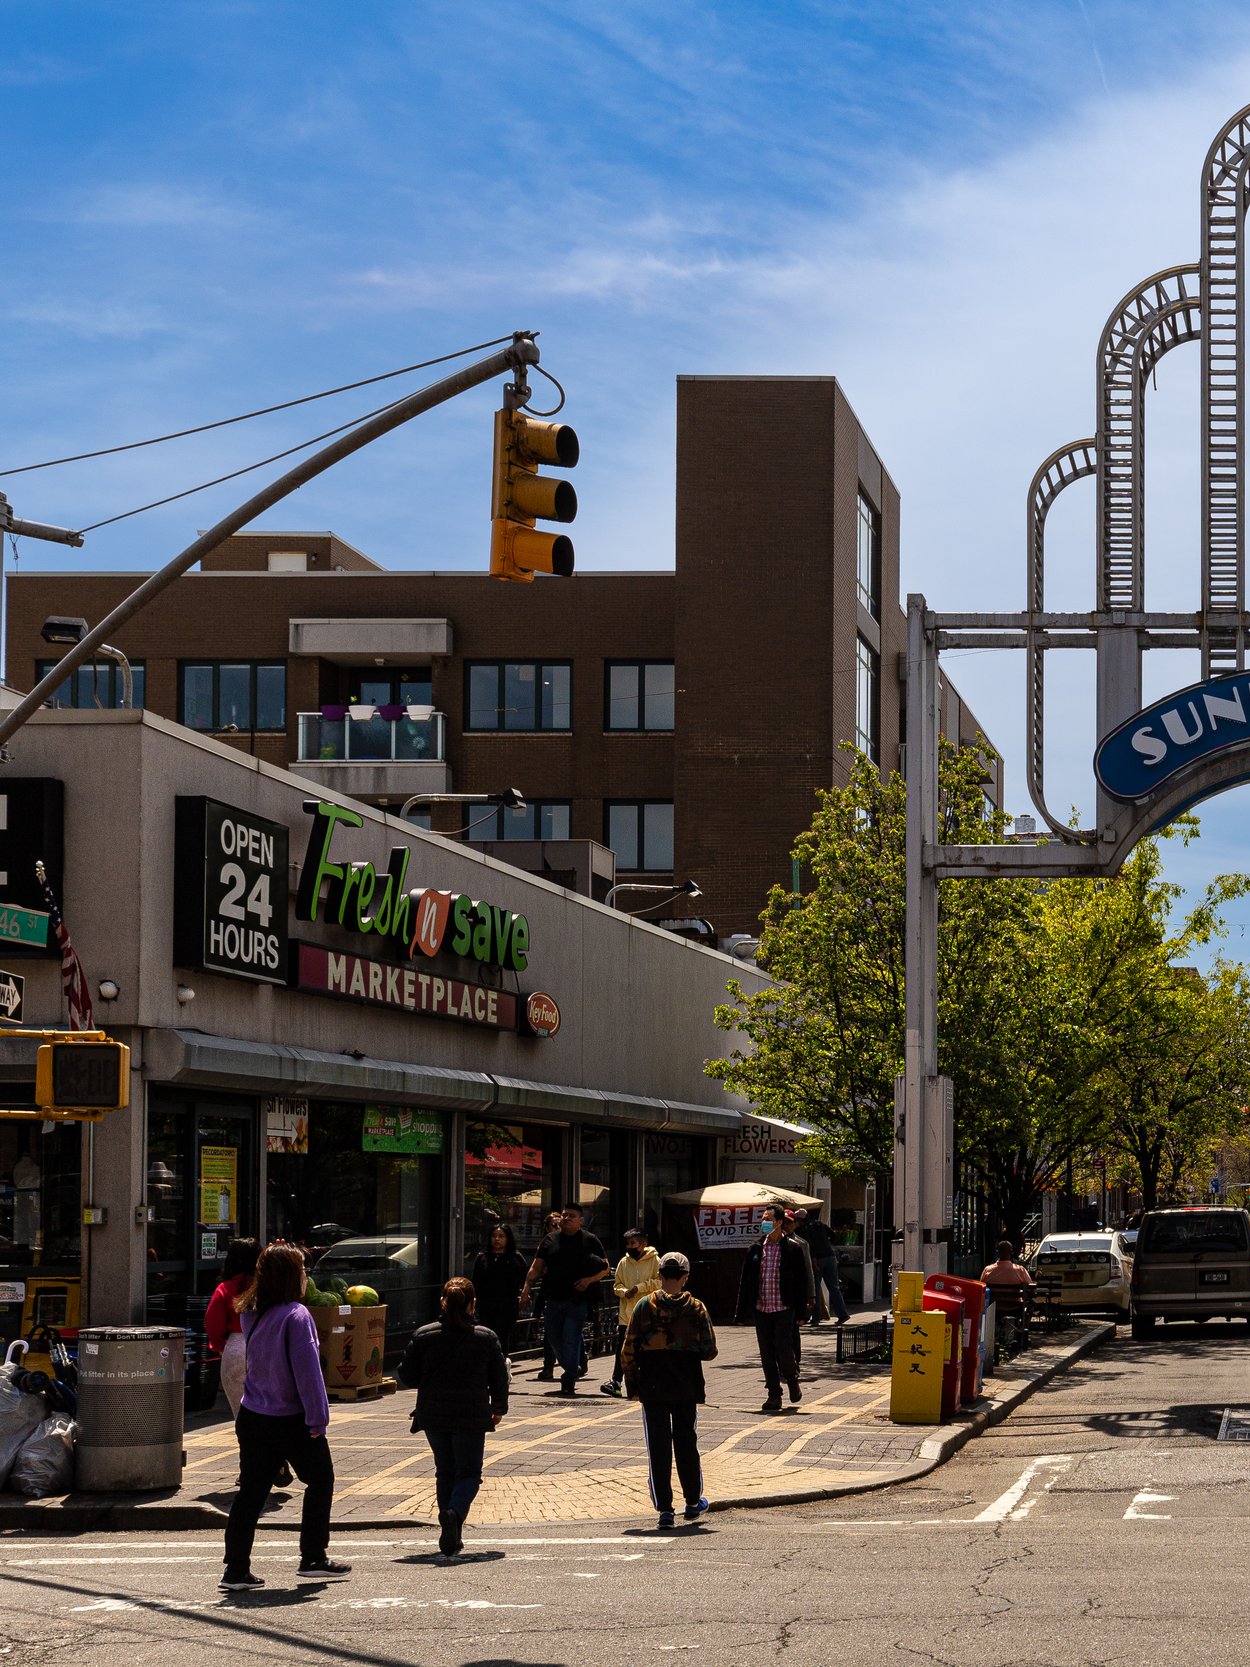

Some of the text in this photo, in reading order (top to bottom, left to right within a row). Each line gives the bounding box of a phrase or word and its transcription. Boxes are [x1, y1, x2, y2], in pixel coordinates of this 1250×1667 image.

[220, 819, 274, 869] OPEN
[219, 862, 273, 928] 24
[310, 801, 410, 944] Fresh
[452, 894, 530, 972] save
[0, 910, 20, 937] 46
[210, 919, 279, 969] HOURS
[327, 951, 498, 1024] MARKETPLACE
[724, 1139, 796, 1154] FLOWERS
[699, 1206, 767, 1226] FREE
[699, 1225, 762, 1237] COVID TES
[107, 1371, 115, 1379] in
[117, 1370, 129, 1379] its
[131, 1369, 155, 1379] place
